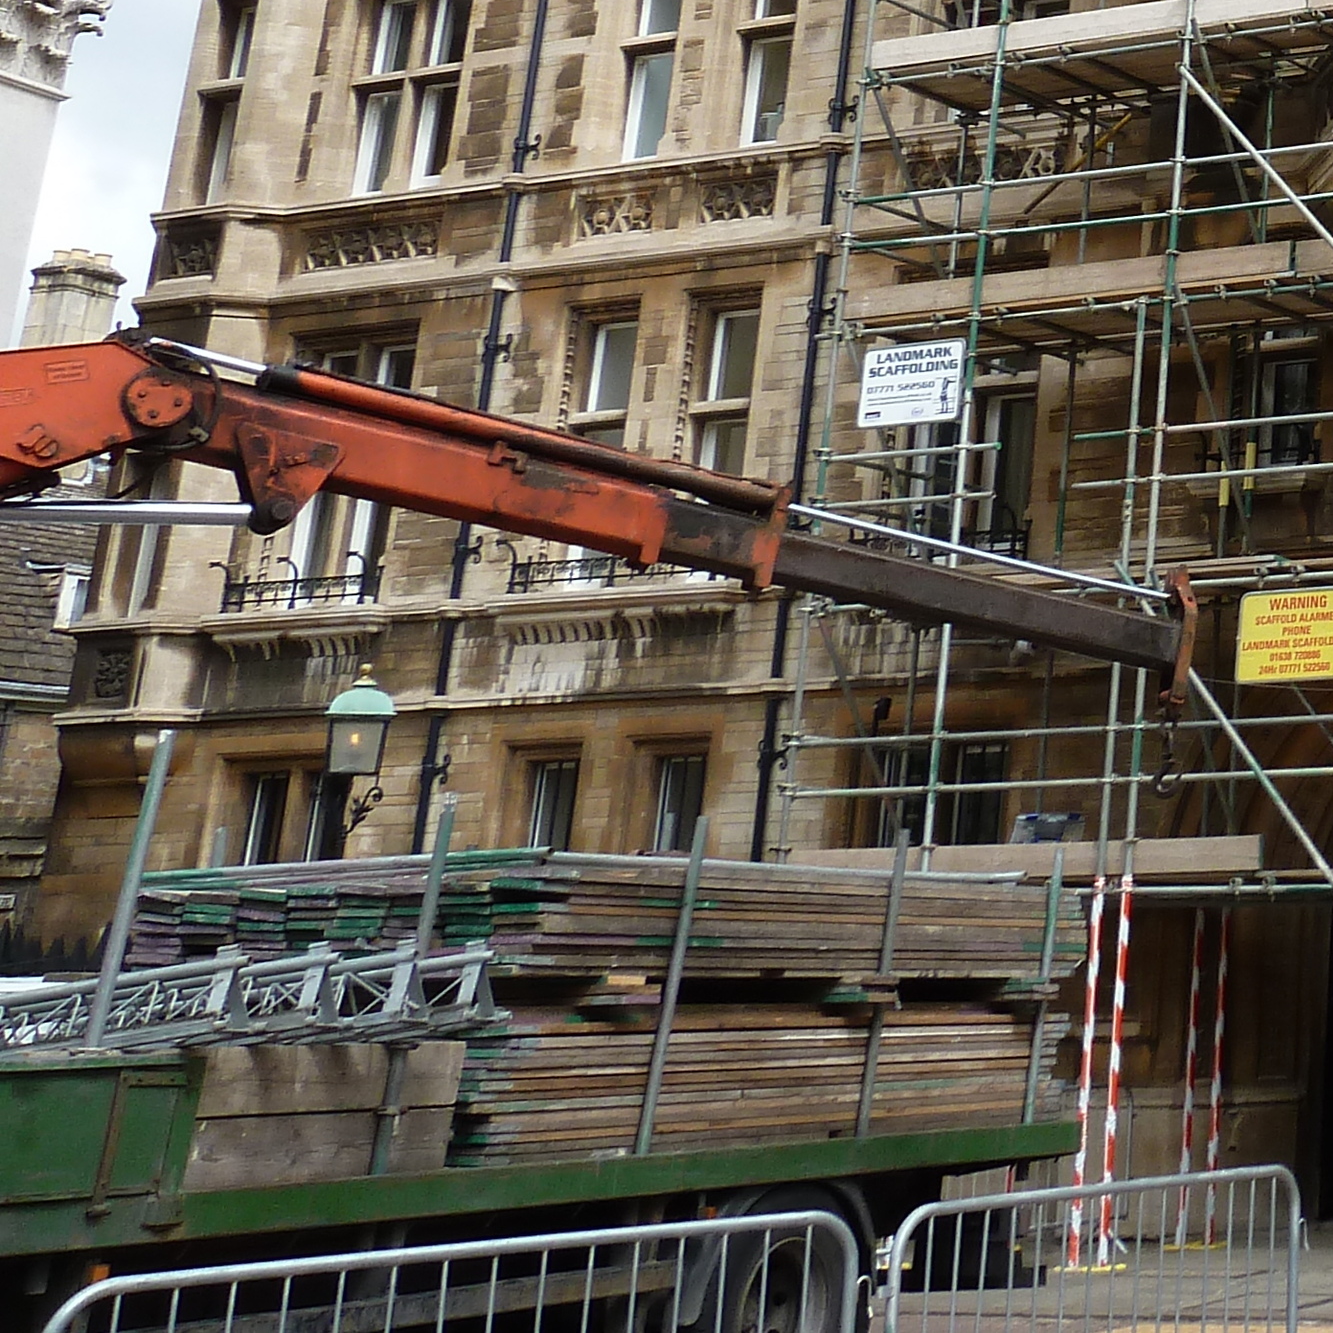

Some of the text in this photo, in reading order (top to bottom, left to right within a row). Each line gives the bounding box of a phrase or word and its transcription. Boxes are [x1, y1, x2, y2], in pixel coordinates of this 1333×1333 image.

[876, 346, 953, 364] LANDMARK
[868, 359, 959, 378] SCAFFOLDING
[866, 385, 894, 395] 07771
[1269, 595, 1328, 611] WARNING
[1255, 613, 1297, 626] SCAFFOLD
[1282, 625, 1312, 636] PHONE
[1242, 639, 1290, 652] LANDMARK
